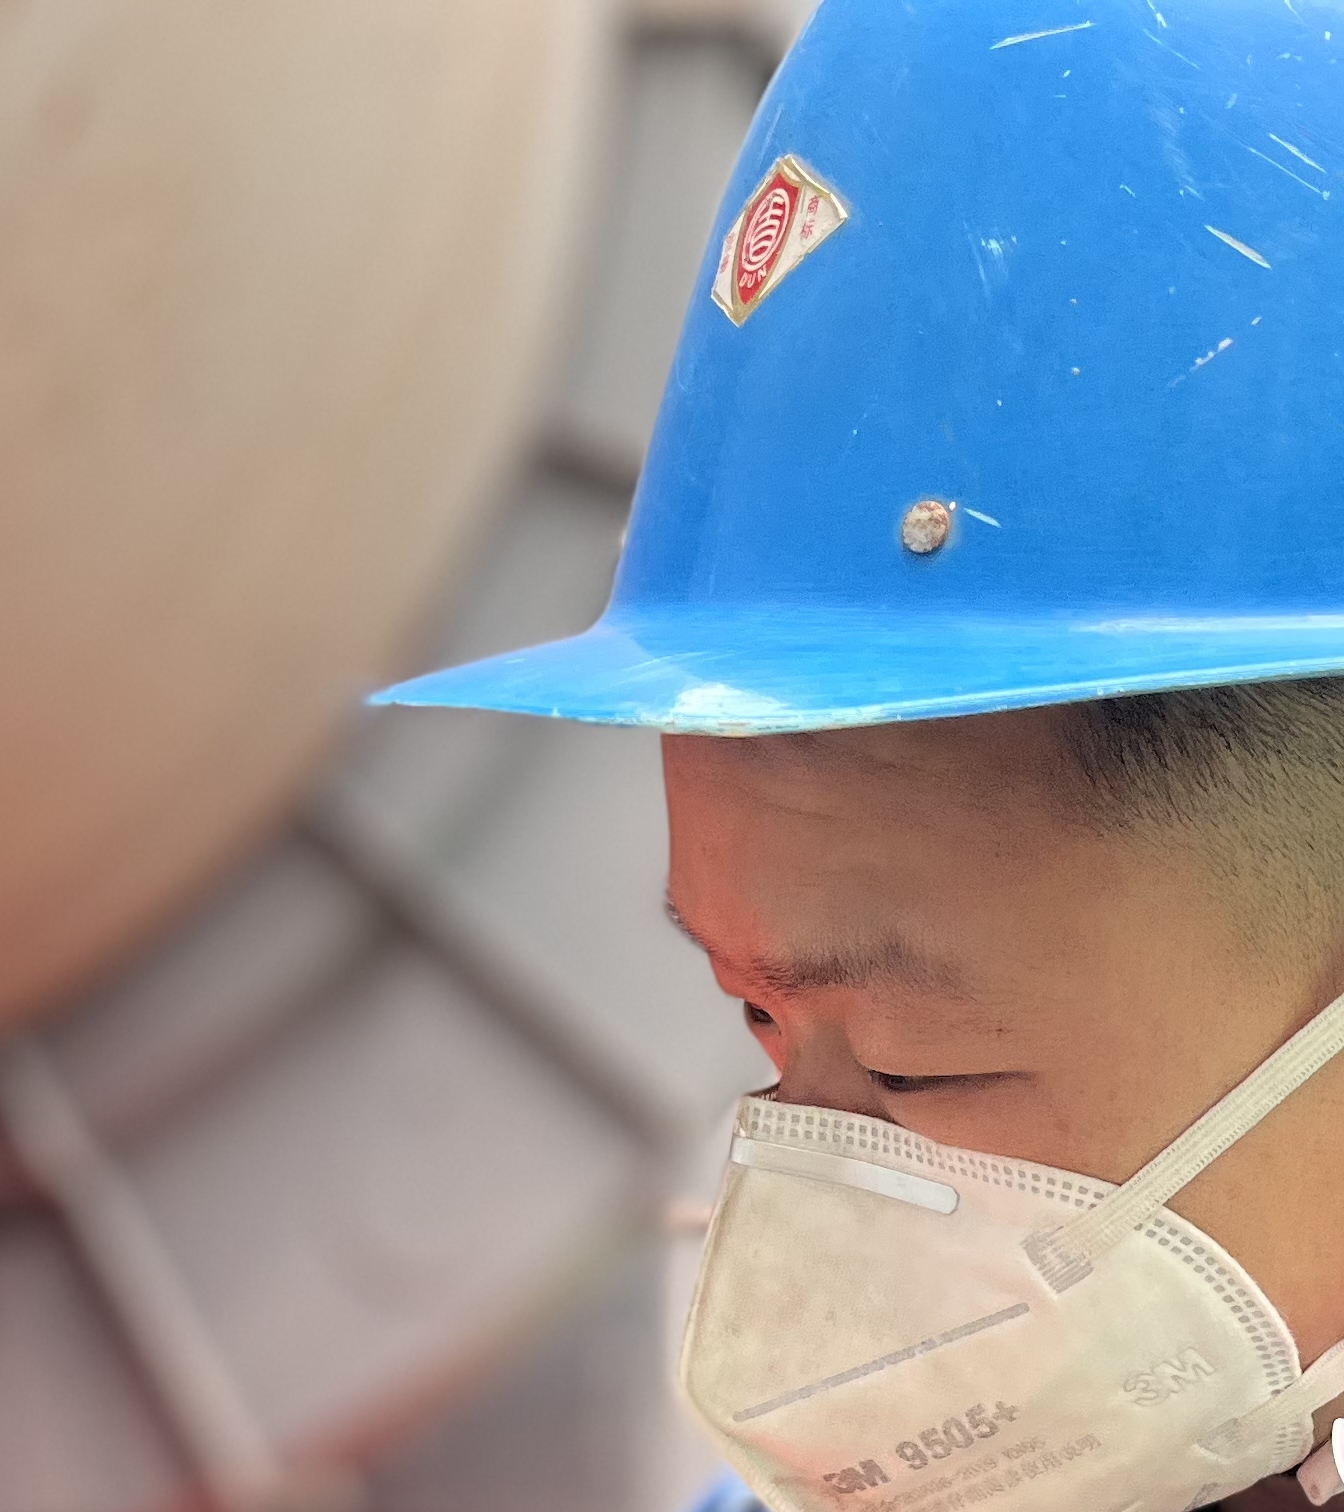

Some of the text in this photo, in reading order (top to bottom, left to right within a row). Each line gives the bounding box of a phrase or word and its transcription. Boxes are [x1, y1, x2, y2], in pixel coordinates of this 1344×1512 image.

[1123, 1345, 1217, 1408] 3M
[823, 1459, 892, 1494] 3M
[895, 1400, 1021, 1470] 9505+
